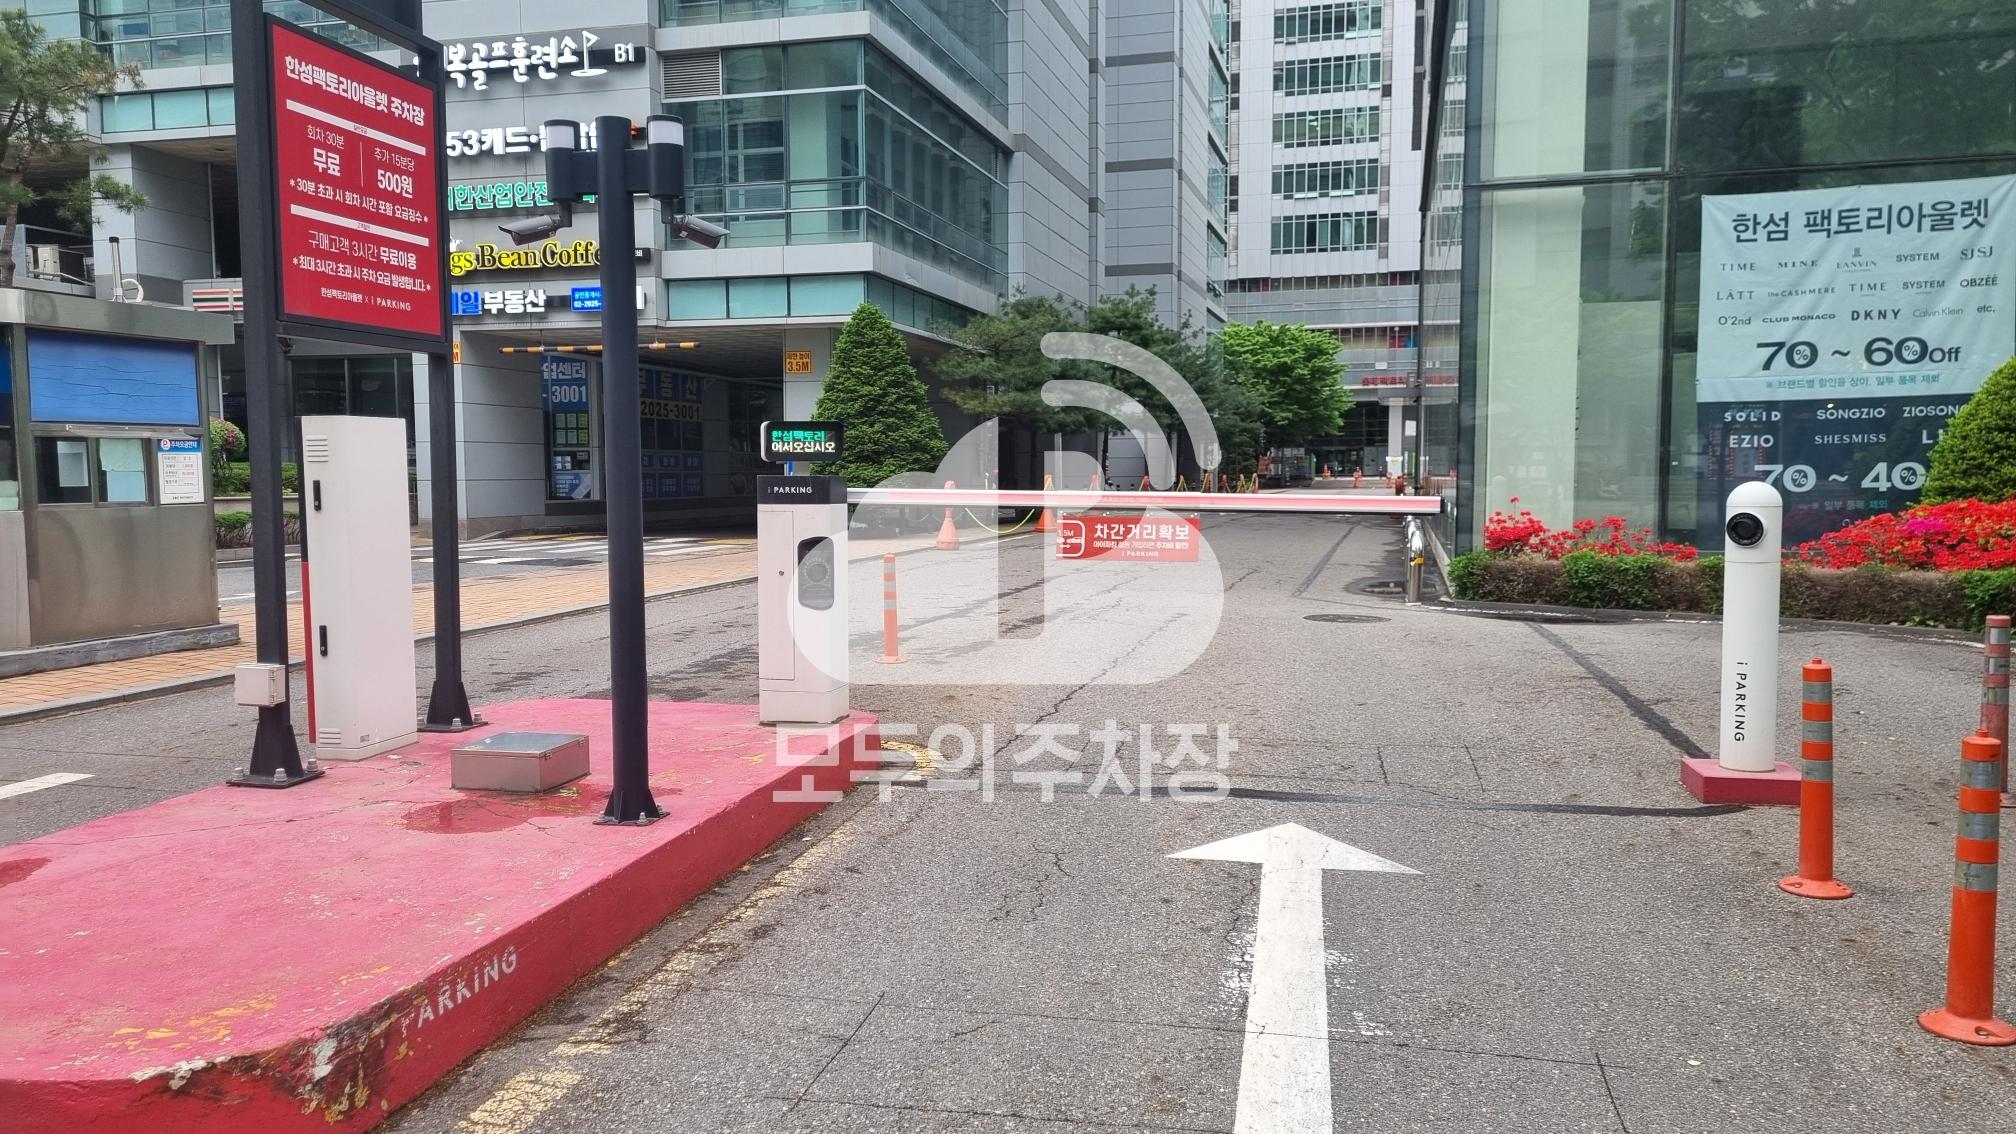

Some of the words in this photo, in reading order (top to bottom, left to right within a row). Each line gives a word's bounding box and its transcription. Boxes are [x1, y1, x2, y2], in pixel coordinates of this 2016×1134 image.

[444, 35, 580, 91] 복골프훈련소
[614, 42, 635, 63] B1
[285, 55, 388, 113] 한섬팩토리아울렛
[391, 96, 425, 127] 주차장
[307, 125, 325, 142] 회차
[326, 131, 345, 150] 30분
[313, 147, 341, 177] 무료
[373, 147, 390, 164] 추가
[391, 153, 415, 172] 15분당
[377, 168, 413, 199] 500원
[448, 181, 554, 211] 한산업안전
[297, 178, 316, 196] 30분
[317, 183, 334, 201] 초과
[335, 188, 343, 203] 시
[344, 190, 361, 207] 회차
[361, 195, 377, 212] 시간
[378, 200, 393, 216] 포함
[1732, 210, 1790, 243] 한섬
[1803, 197, 1989, 239] 팩토리아울렛
[308, 230, 350, 256] 구매고객
[351, 240, 378, 262] 3시간
[380, 246, 417, 270] 무료이용
[477, 243, 540, 269] Bean
[1720, 262, 1756, 272] TIME
[1778, 259, 1819, 269] MINE
[1836, 260, 1878, 270] LANVIN
[1895, 252, 1940, 263] SYSTEM
[337, 262, 353, 279] 초과
[353, 266, 360, 280] 시
[361, 267, 376, 284] 주차
[376, 271, 391, 287] 요금
[1849, 282, 1887, 293] TIME
[1902, 280, 1945, 290] SYSTEM
[377, 297, 411, 311] PARKING
[484, 288, 547, 315] 부동산
[1791, 313, 1836, 322] MONACO
[1851, 308, 1901, 321] DKNY
[1912, 308, 1940, 319] Calvin
[787, 361, 809, 372] 3.5M
[1724, 411, 1781, 422] SOLID
[1816, 407, 1886, 420] SONGZIO
[771, 430, 826, 442] 한섬팩토리
[771, 441, 836, 453] 어서오십시오
[1729, 434, 1774, 448] EZIO
[1814, 433, 1887, 444] SHESMISS
[773, 486, 812, 494] PARKING
[1734, 673, 1748, 742] PARKING
